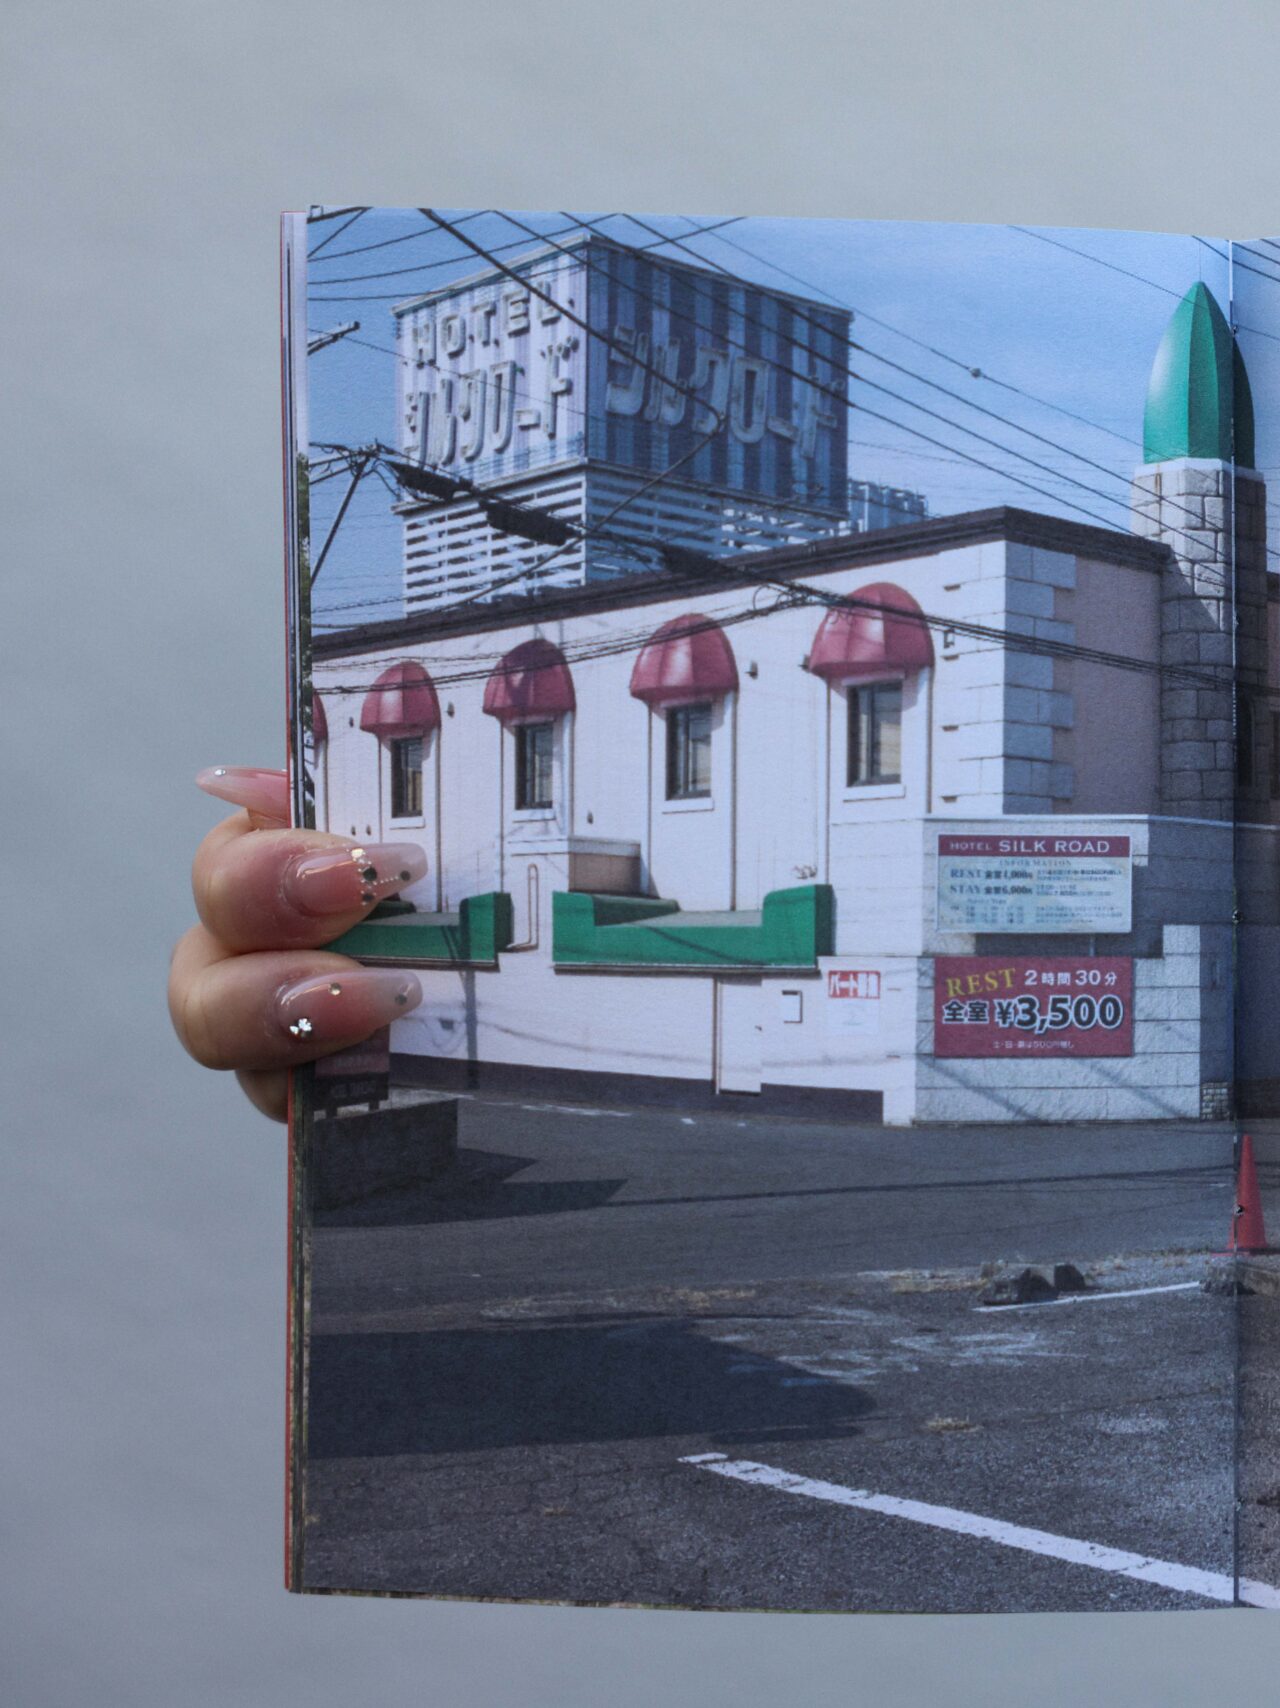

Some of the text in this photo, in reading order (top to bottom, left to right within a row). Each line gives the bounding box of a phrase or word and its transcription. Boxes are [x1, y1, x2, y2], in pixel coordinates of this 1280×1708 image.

[412, 280, 562, 370] HOTEL
[403, 335, 581, 469] シルクロード
[604, 325, 846, 459] シルクロード
[949, 840, 1110, 853] HOTEL SILK ROAD
[942, 994, 1123, 1034] 全室 ¥3,500
[946, 968, 1016, 998] REST
